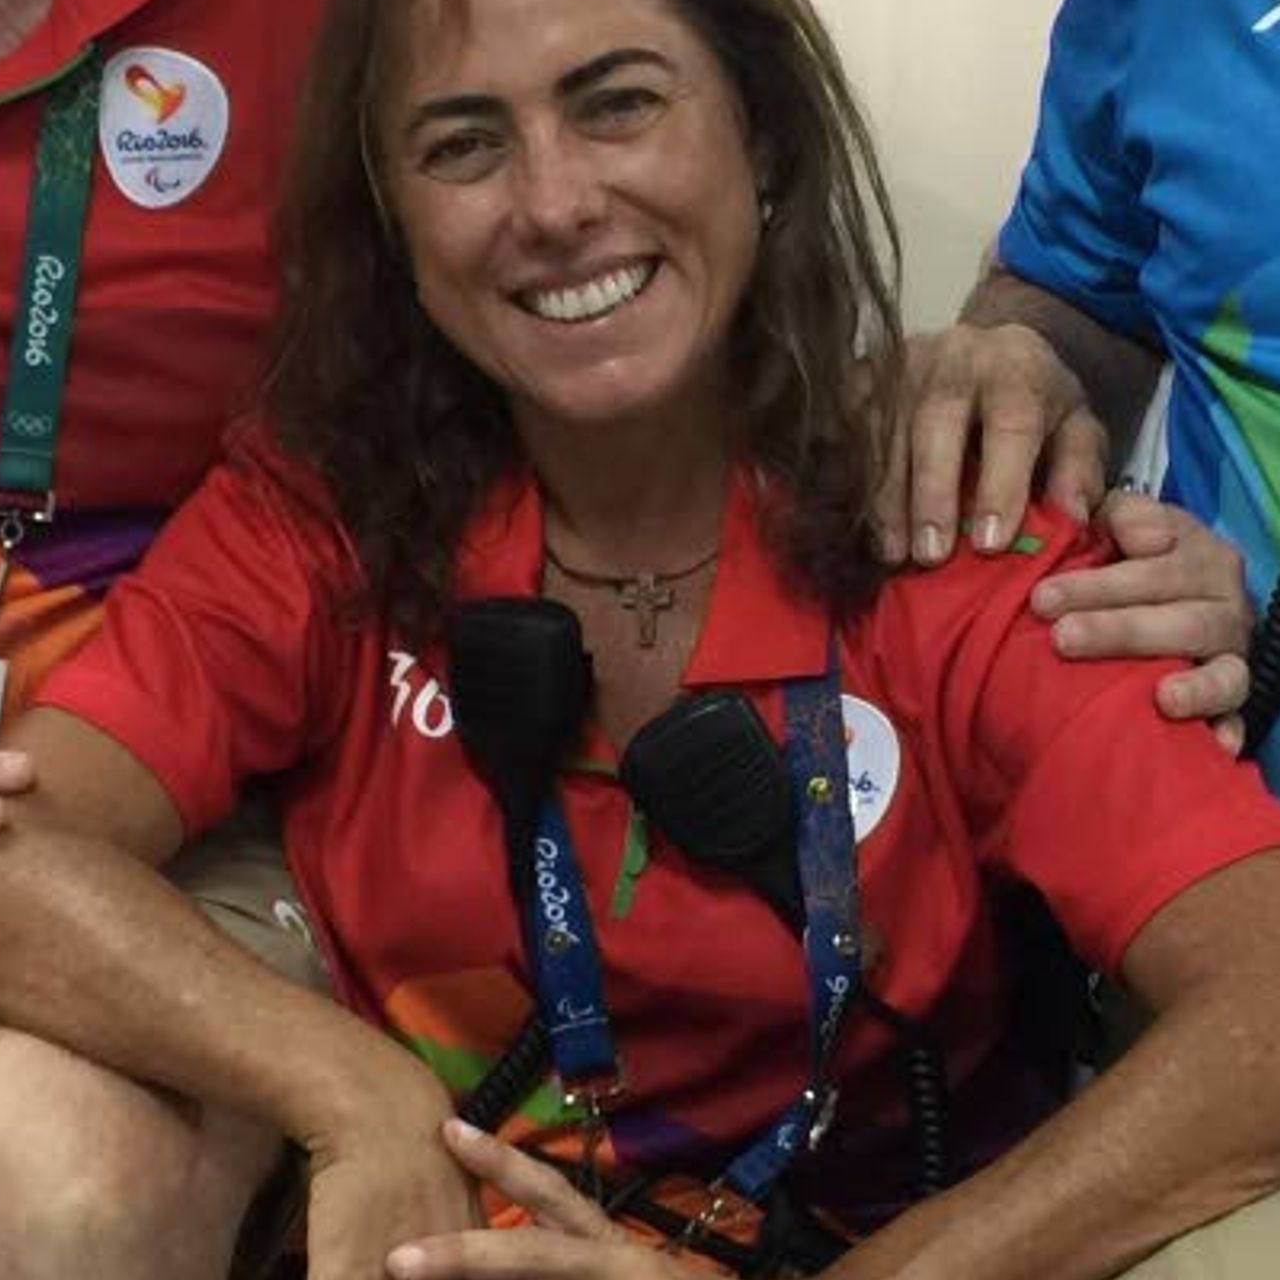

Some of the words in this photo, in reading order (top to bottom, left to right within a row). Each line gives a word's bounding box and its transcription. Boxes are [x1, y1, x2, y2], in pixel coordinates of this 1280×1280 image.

[116, 128, 203, 152] Rio2016
[24, 255, 65, 366] Rio2016
[387, 651, 455, 739] 36
